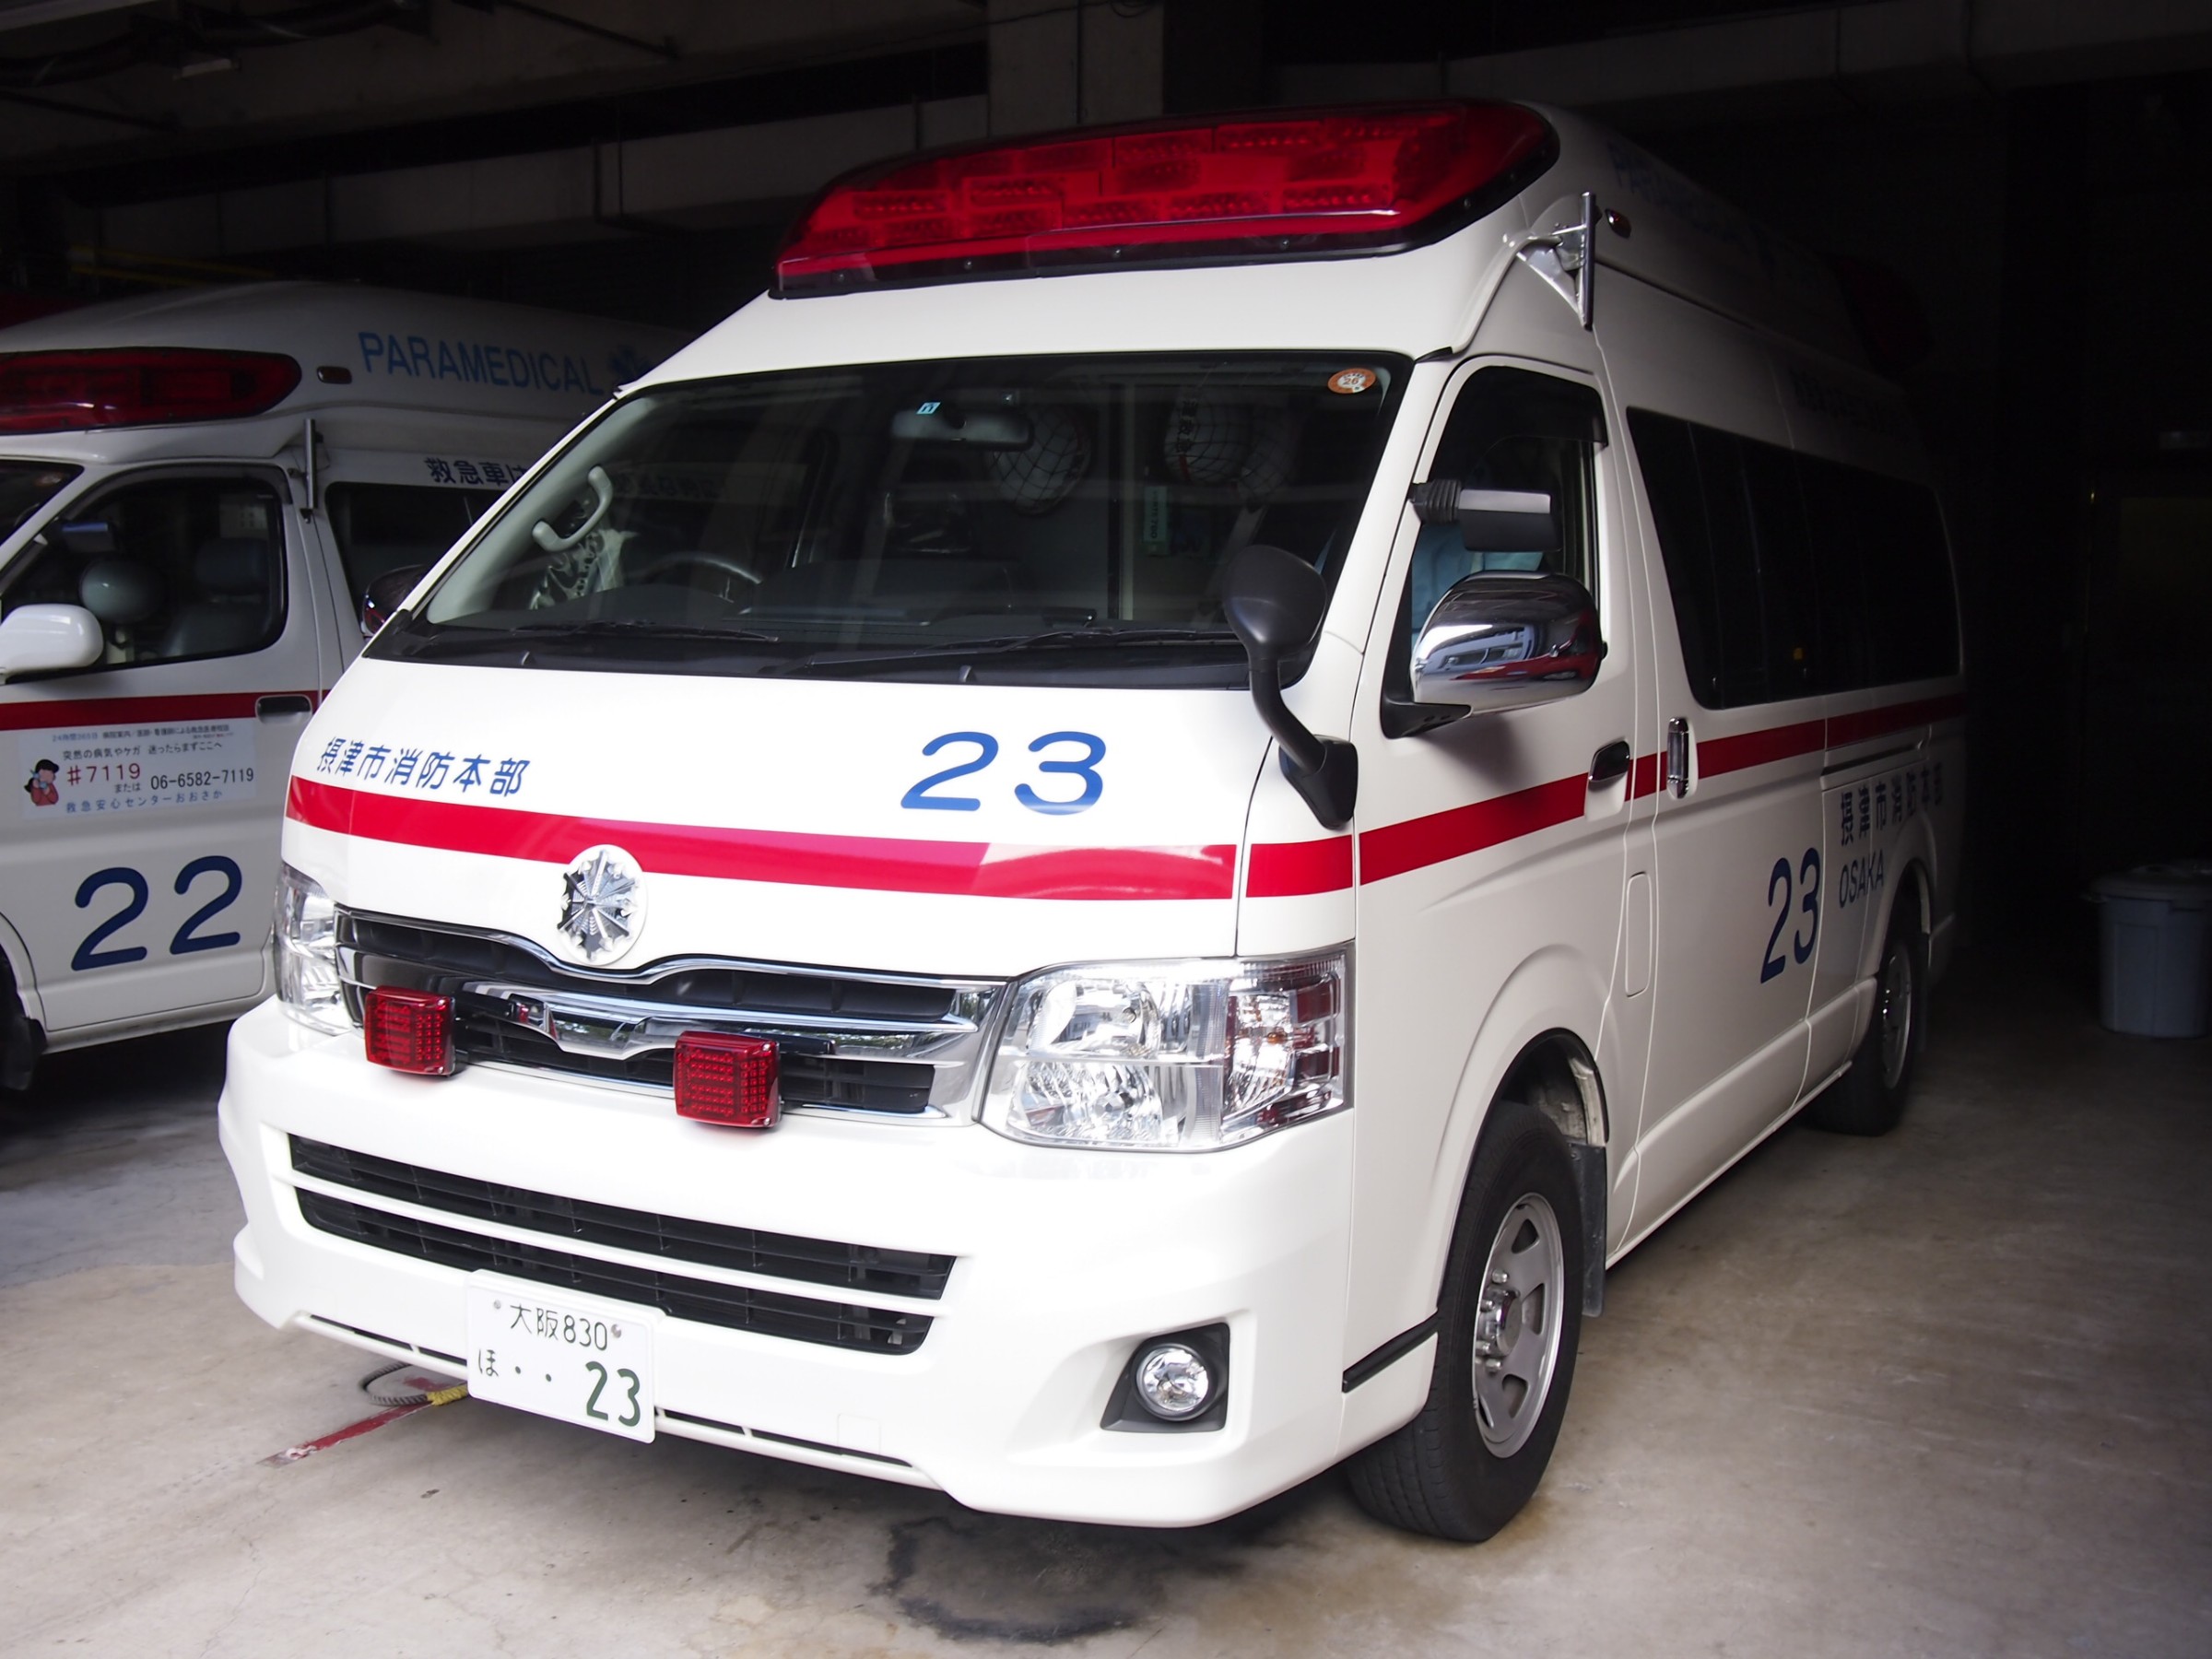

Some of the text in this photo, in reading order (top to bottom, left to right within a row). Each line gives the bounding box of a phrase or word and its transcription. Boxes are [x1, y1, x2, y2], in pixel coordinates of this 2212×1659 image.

[359, 332, 604, 394] PARAMEDICAL
[63, 745, 141, 761] 突然の病気やケガ
[150, 767, 254, 791] 06-6582-7119
[317, 735, 531, 797] 摂津市消防本部
[900, 731, 1106, 816] 23
[65, 790, 223, 814] 救急安心センターおおさか
[114, 782, 141, 794] または
[1839, 849, 1884, 909] OSAKA
[71, 855, 242, 971] 22
[1760, 847, 1820, 983] 23
